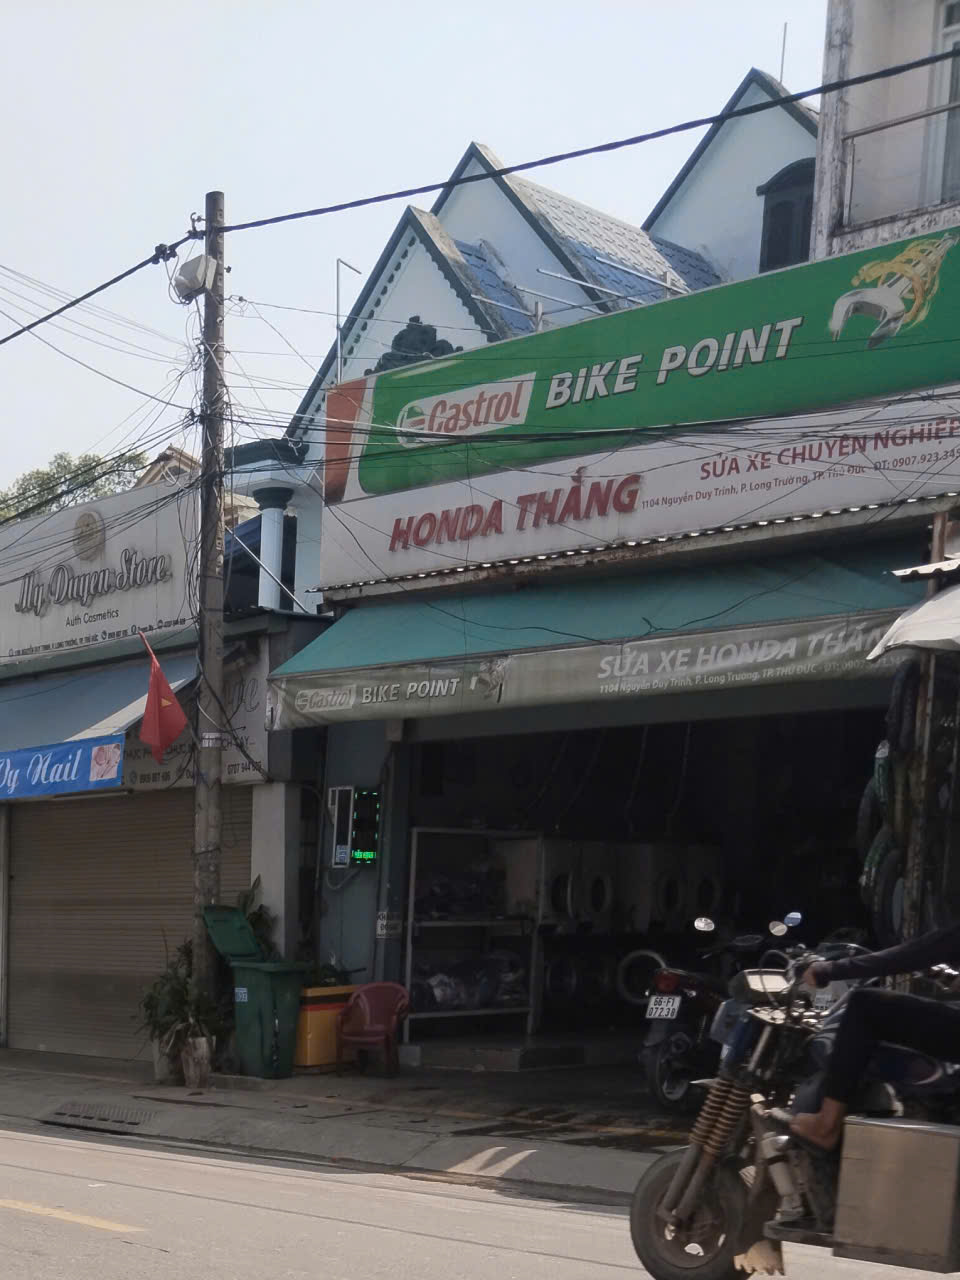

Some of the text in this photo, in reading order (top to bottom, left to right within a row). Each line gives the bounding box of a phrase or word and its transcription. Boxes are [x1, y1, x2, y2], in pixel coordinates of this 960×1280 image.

[545, 316, 804, 410] BIKE POINT
[427, 382, 524, 434] Castrol
[746, 451, 772, 473] XE
[777, 434, 867, 466] CHUYÊN
[388, 466, 645, 552] HONDA THẮNG
[642, 496, 660, 510] 1104
[695, 489, 713, 501] Duy
[741, 482, 748, 493] P.
[749, 480, 772, 492] Long
[116, 548, 173, 591] Store
[65, 608, 120, 627] Auth Cosmetics
[656, 649, 691, 674] XE
[695, 637, 798, 673] HONDA
[308, 687, 351, 710] Castrol
[361, 677, 460, 704] BIKE POINT
[652, 678, 668, 690] Duy
[703, 673, 726, 685] Long
[26, 748, 83, 785] Nail
